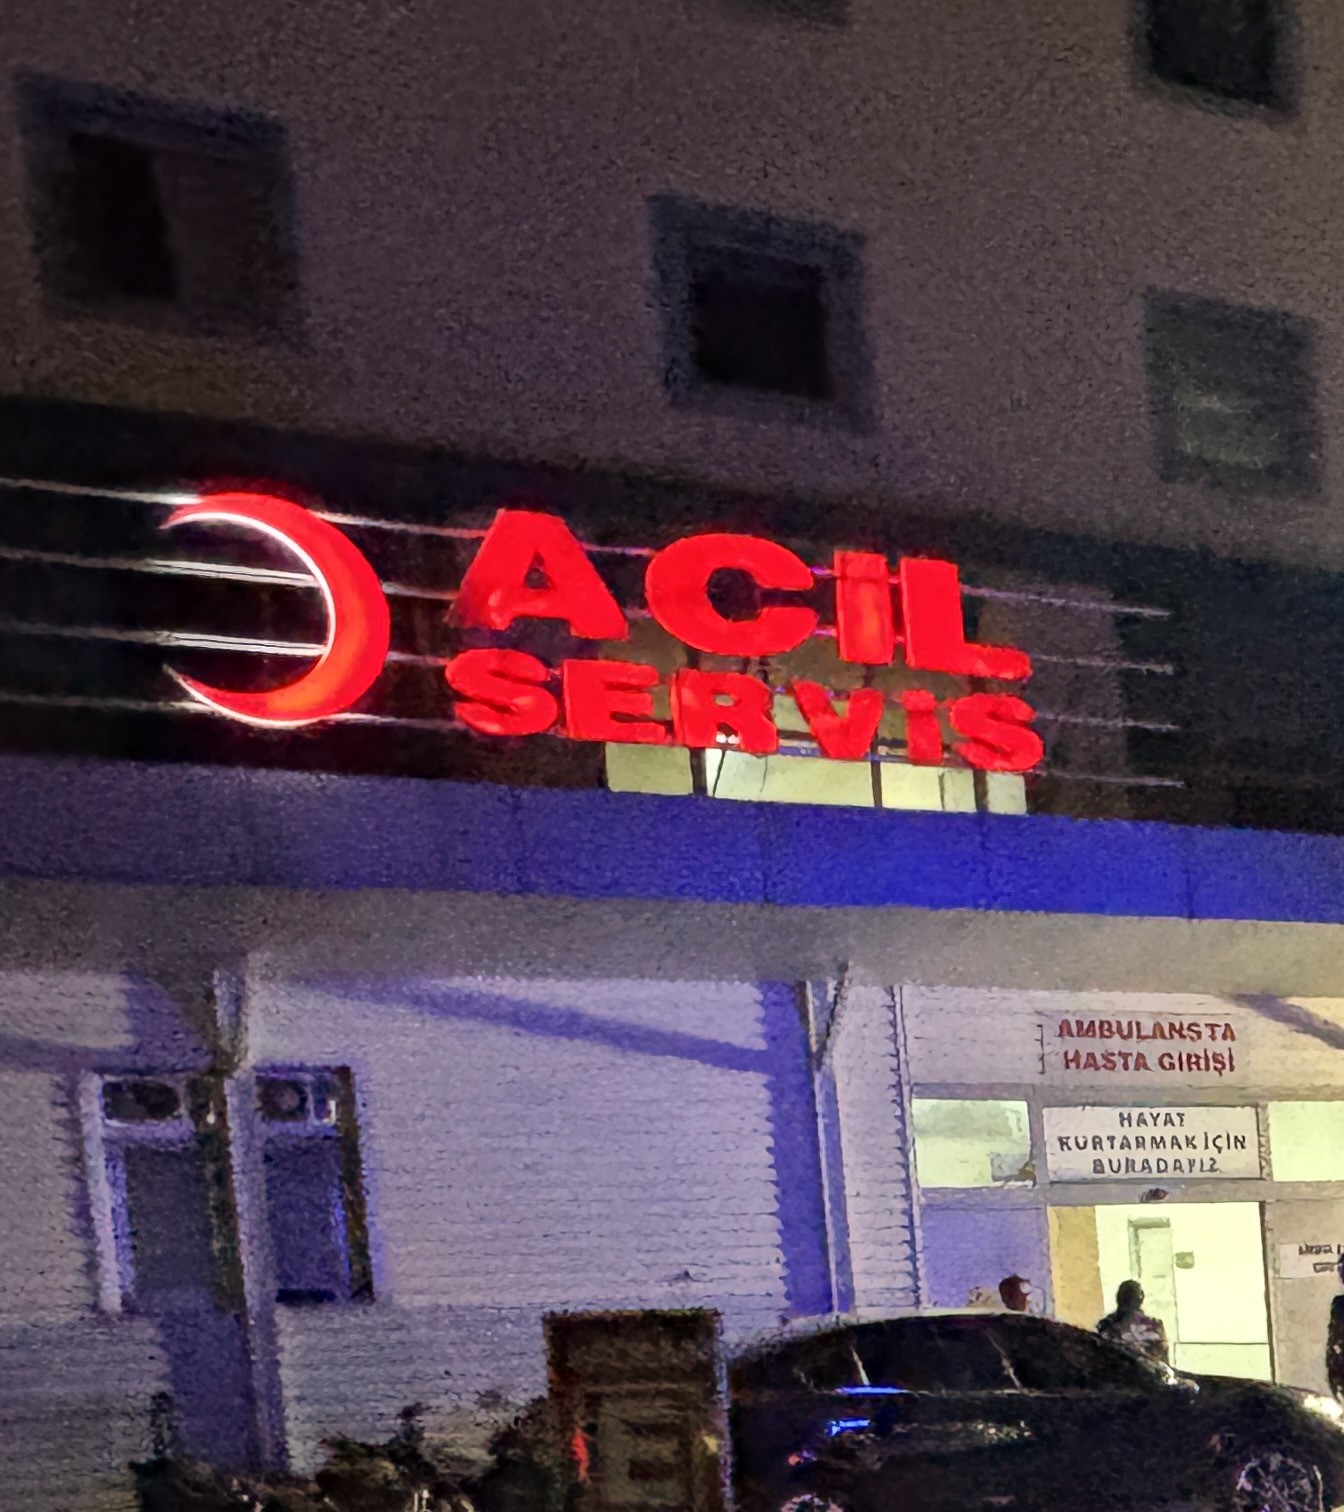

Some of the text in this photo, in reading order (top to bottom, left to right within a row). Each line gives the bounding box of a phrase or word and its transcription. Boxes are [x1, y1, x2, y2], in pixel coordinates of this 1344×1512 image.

[448, 508, 1032, 680] ACİL
[445, 648, 1044, 772] SERVİS
[1058, 1019, 1236, 1042] AMBULANSTA
[1063, 1050, 1153, 1072] HASTA
[1118, 1111, 1186, 1128] HAYAT
[1057, 1130, 1247, 1154] KURTARMAK İÇİN
